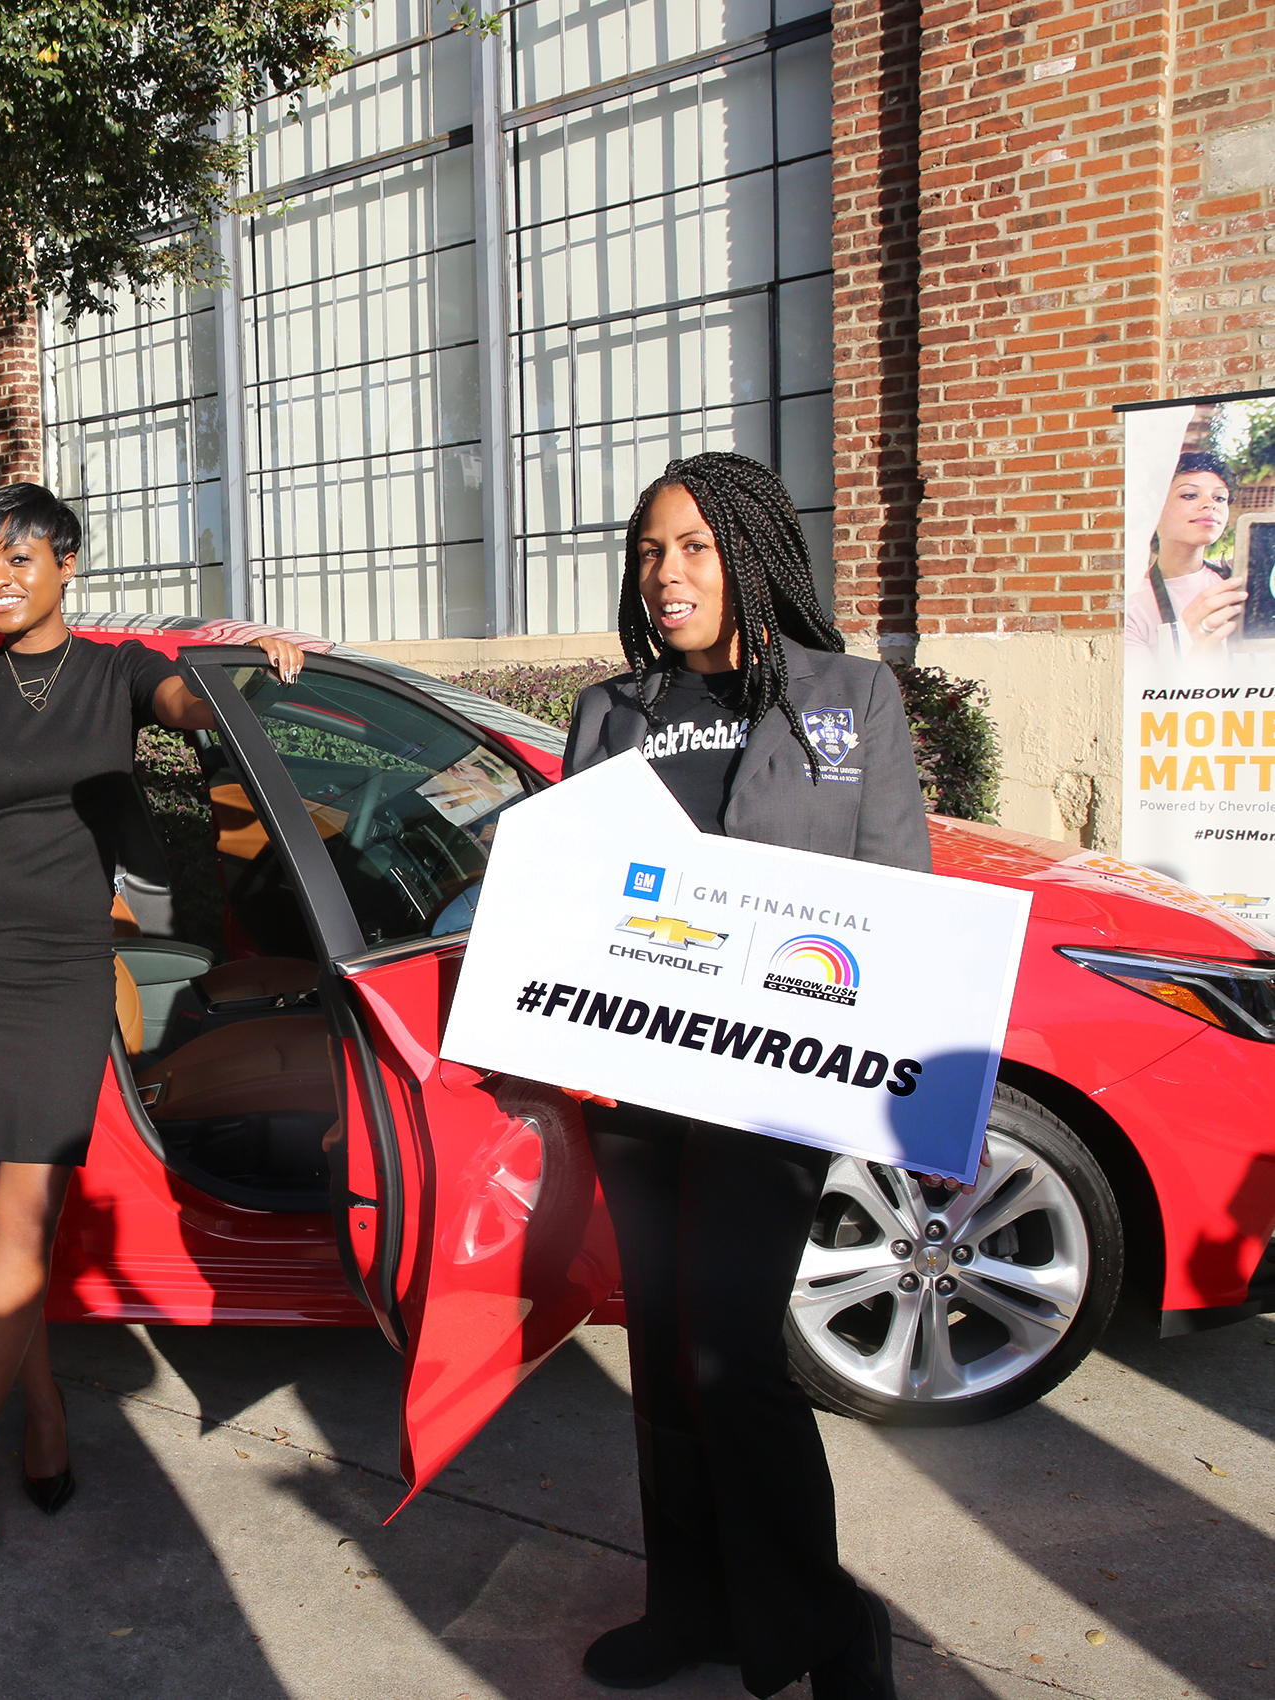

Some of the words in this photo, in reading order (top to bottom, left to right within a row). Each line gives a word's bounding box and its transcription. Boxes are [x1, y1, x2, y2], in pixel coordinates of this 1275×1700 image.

[1141, 687, 1240, 700] RAINBOW
[1244, 687, 1275, 699] PU
[643, 719, 750, 760] ackTechM
[1140, 755, 1275, 792] MATT
[1139, 799, 1196, 811] Powered
[1200, 800, 1215, 814] by
[1218, 800, 1275, 812] Chevrole
[633, 871, 657, 890] GM
[692, 886, 728, 905] GM
[740, 894, 872, 932] FINANCIAL
[608, 944, 723, 976] CHEVROLET
[765, 972, 822, 990] RAINBOW
[768, 982, 850, 1004] COALITION
[516, 980, 923, 1098] #FINDNEWROADS
